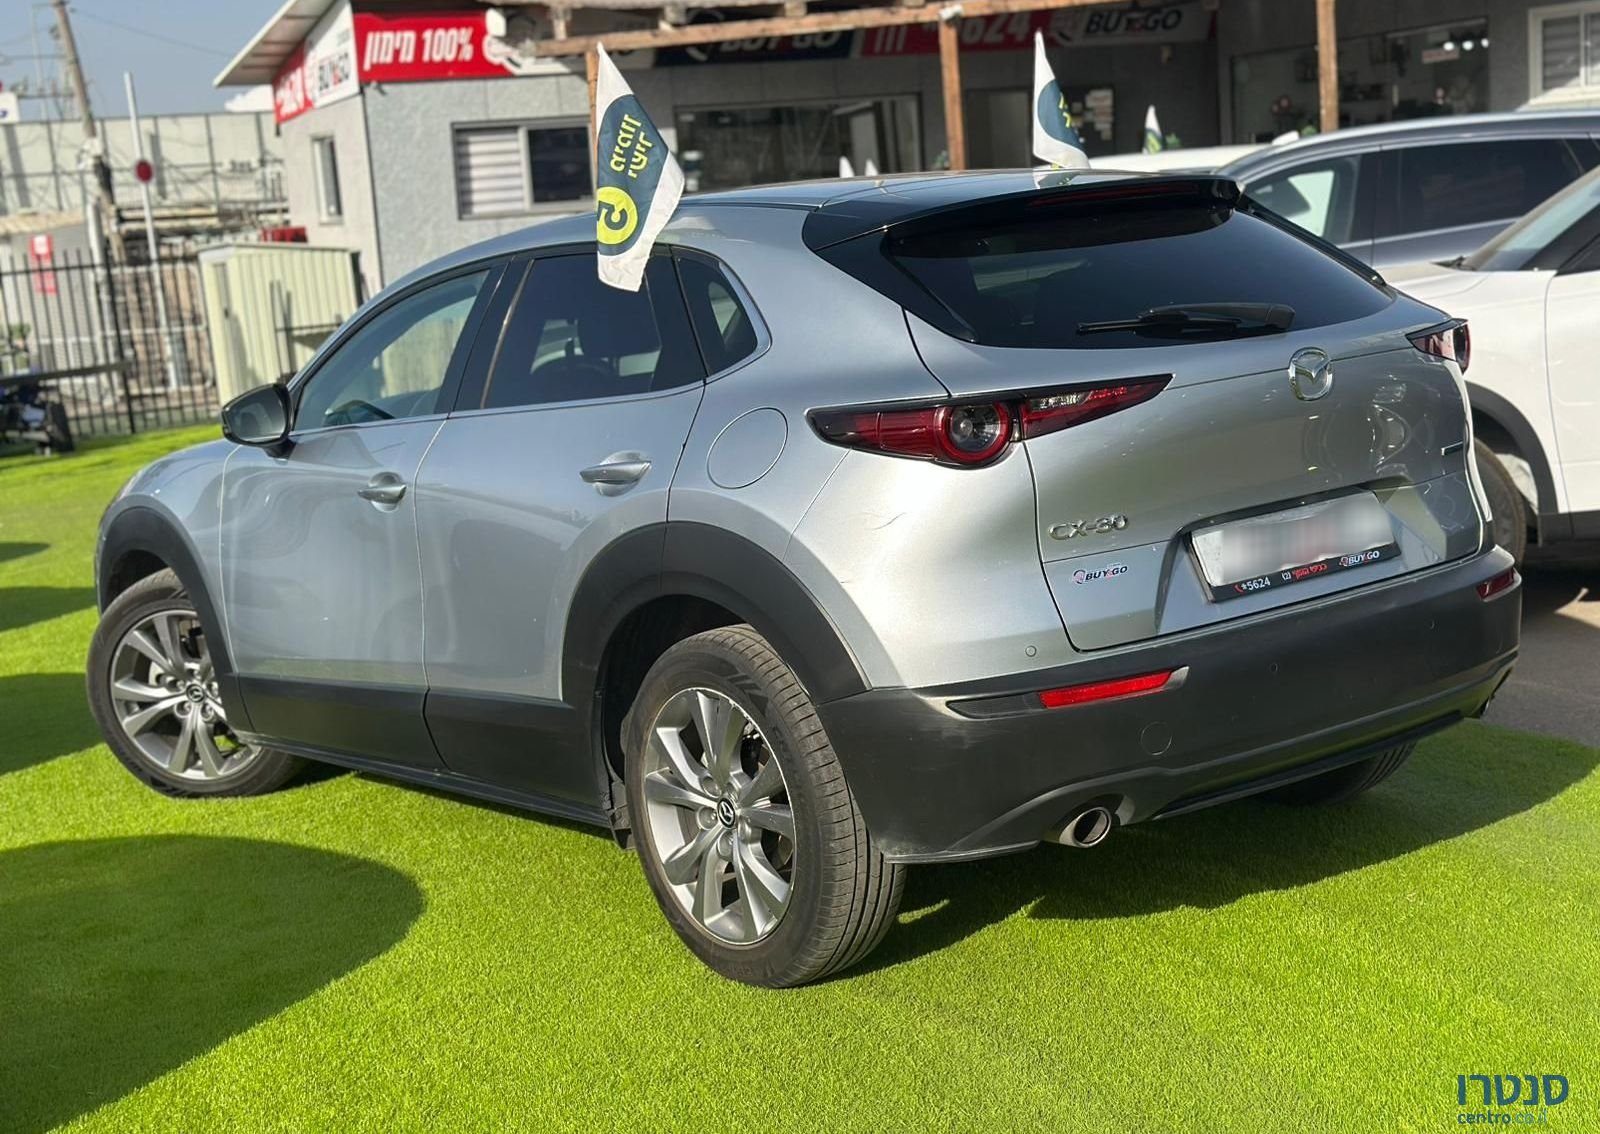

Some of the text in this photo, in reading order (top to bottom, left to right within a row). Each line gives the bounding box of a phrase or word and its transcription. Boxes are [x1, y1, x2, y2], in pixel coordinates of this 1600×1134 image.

[363, 31, 416, 72] מימון
[422, 27, 474, 62] 100%
[1049, 514, 1128, 540] CX-30
